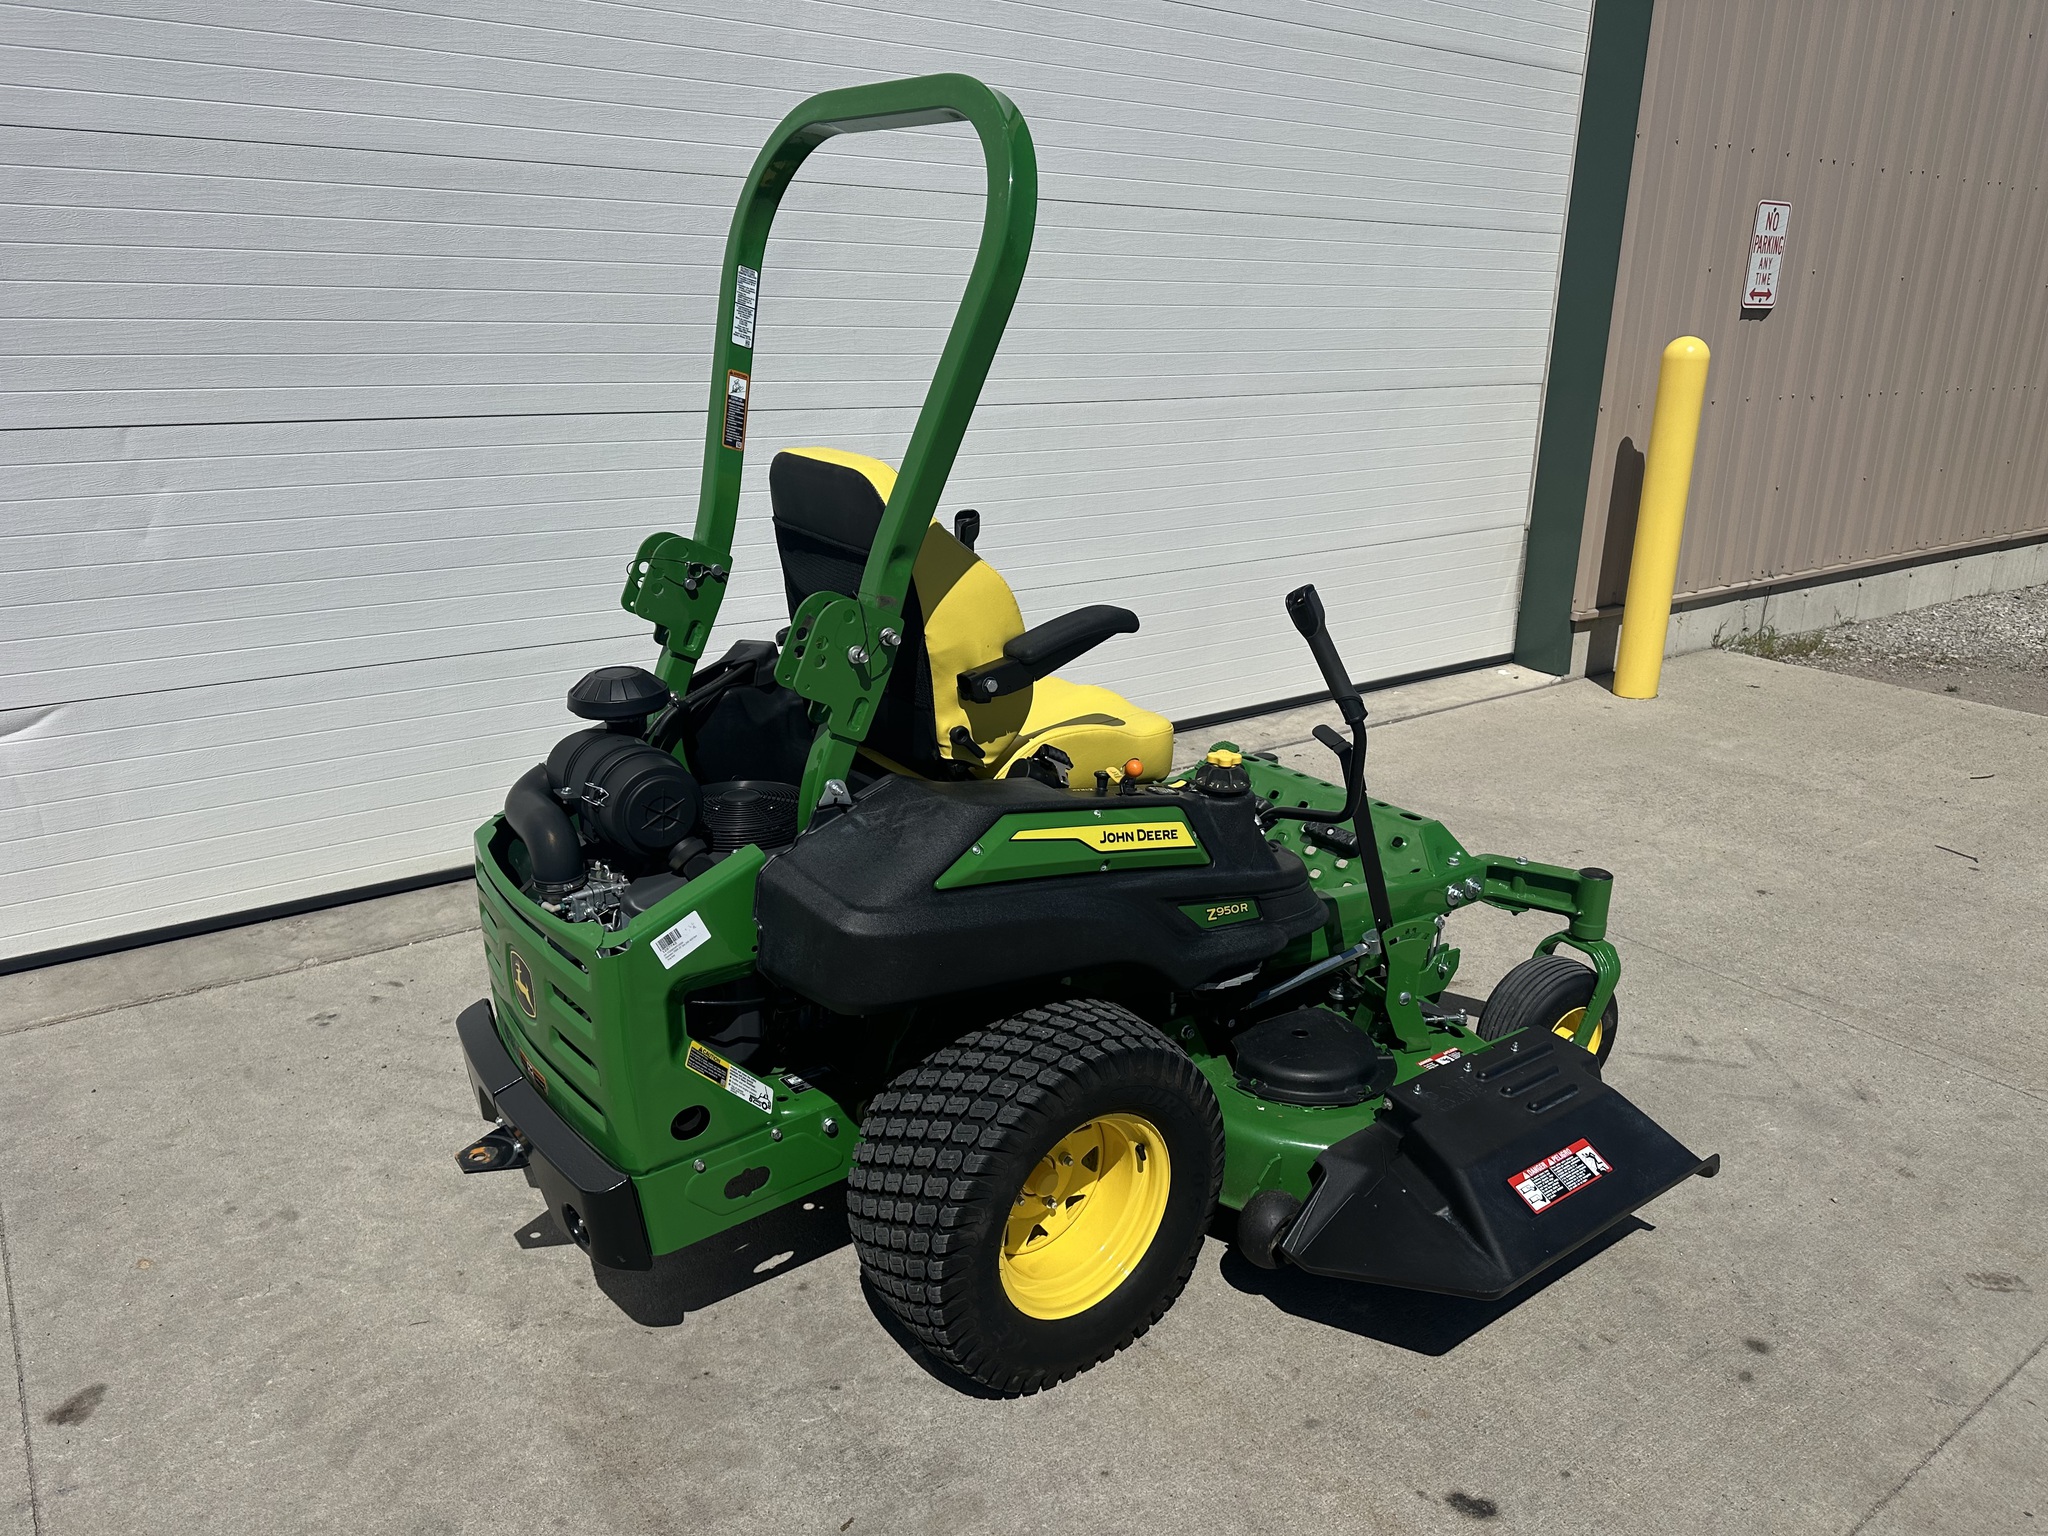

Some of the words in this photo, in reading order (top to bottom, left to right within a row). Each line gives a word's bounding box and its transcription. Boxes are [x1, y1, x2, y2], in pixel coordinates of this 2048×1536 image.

[1765, 211, 1780, 232] NO
[1752, 234, 1784, 255] PARKING
[1758, 257, 1773, 270] ANY
[1755, 273, 1772, 286] TIME
[1100, 830, 1134, 844] JOHN
[1137, 829, 1178, 841] DEERE
[1206, 903, 1248, 921] Z950R
